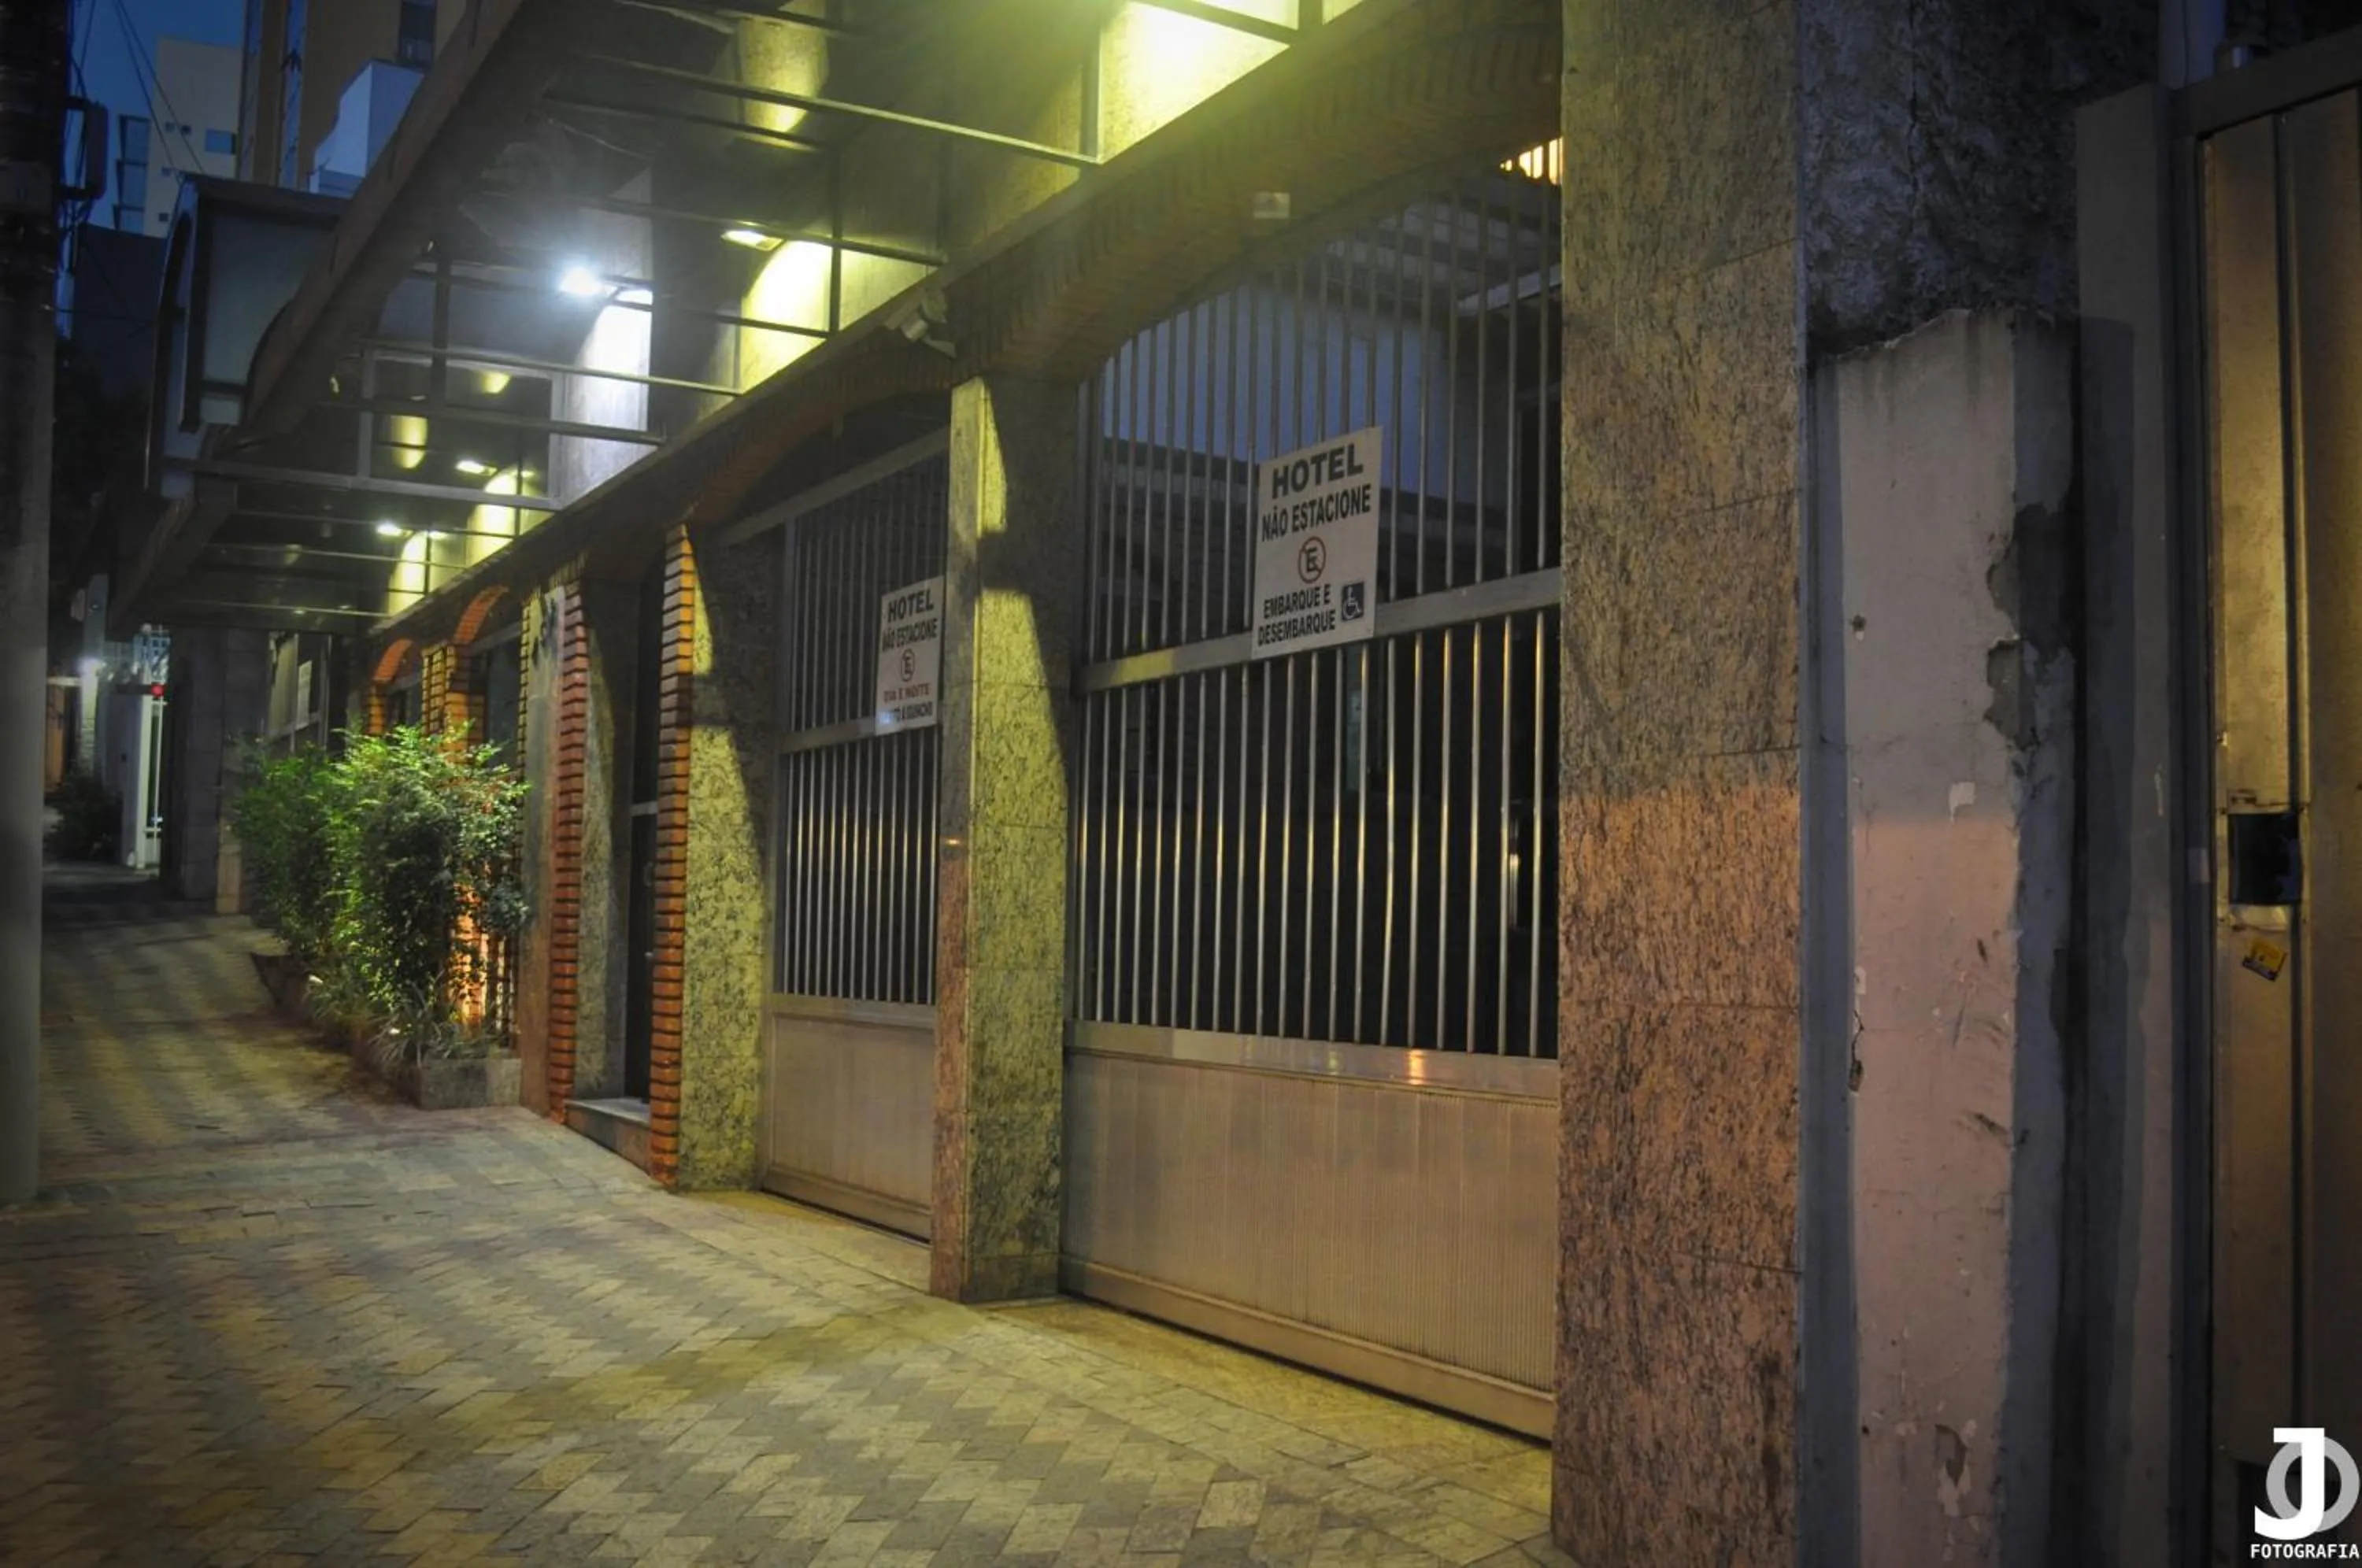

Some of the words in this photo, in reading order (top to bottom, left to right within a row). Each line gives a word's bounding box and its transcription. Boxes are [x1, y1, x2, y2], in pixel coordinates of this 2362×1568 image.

[1272, 442, 1364, 500] HOTEL
[1261, 505, 1289, 542] NÃO
[1291, 483, 1372, 534] ESTACIONE
[887, 590, 935, 623] HOTEL
[1263, 585, 1321, 620] EMBARQUE
[1324, 583, 1331, 606] E
[1257, 609, 1337, 648] DESEMBARQUE
